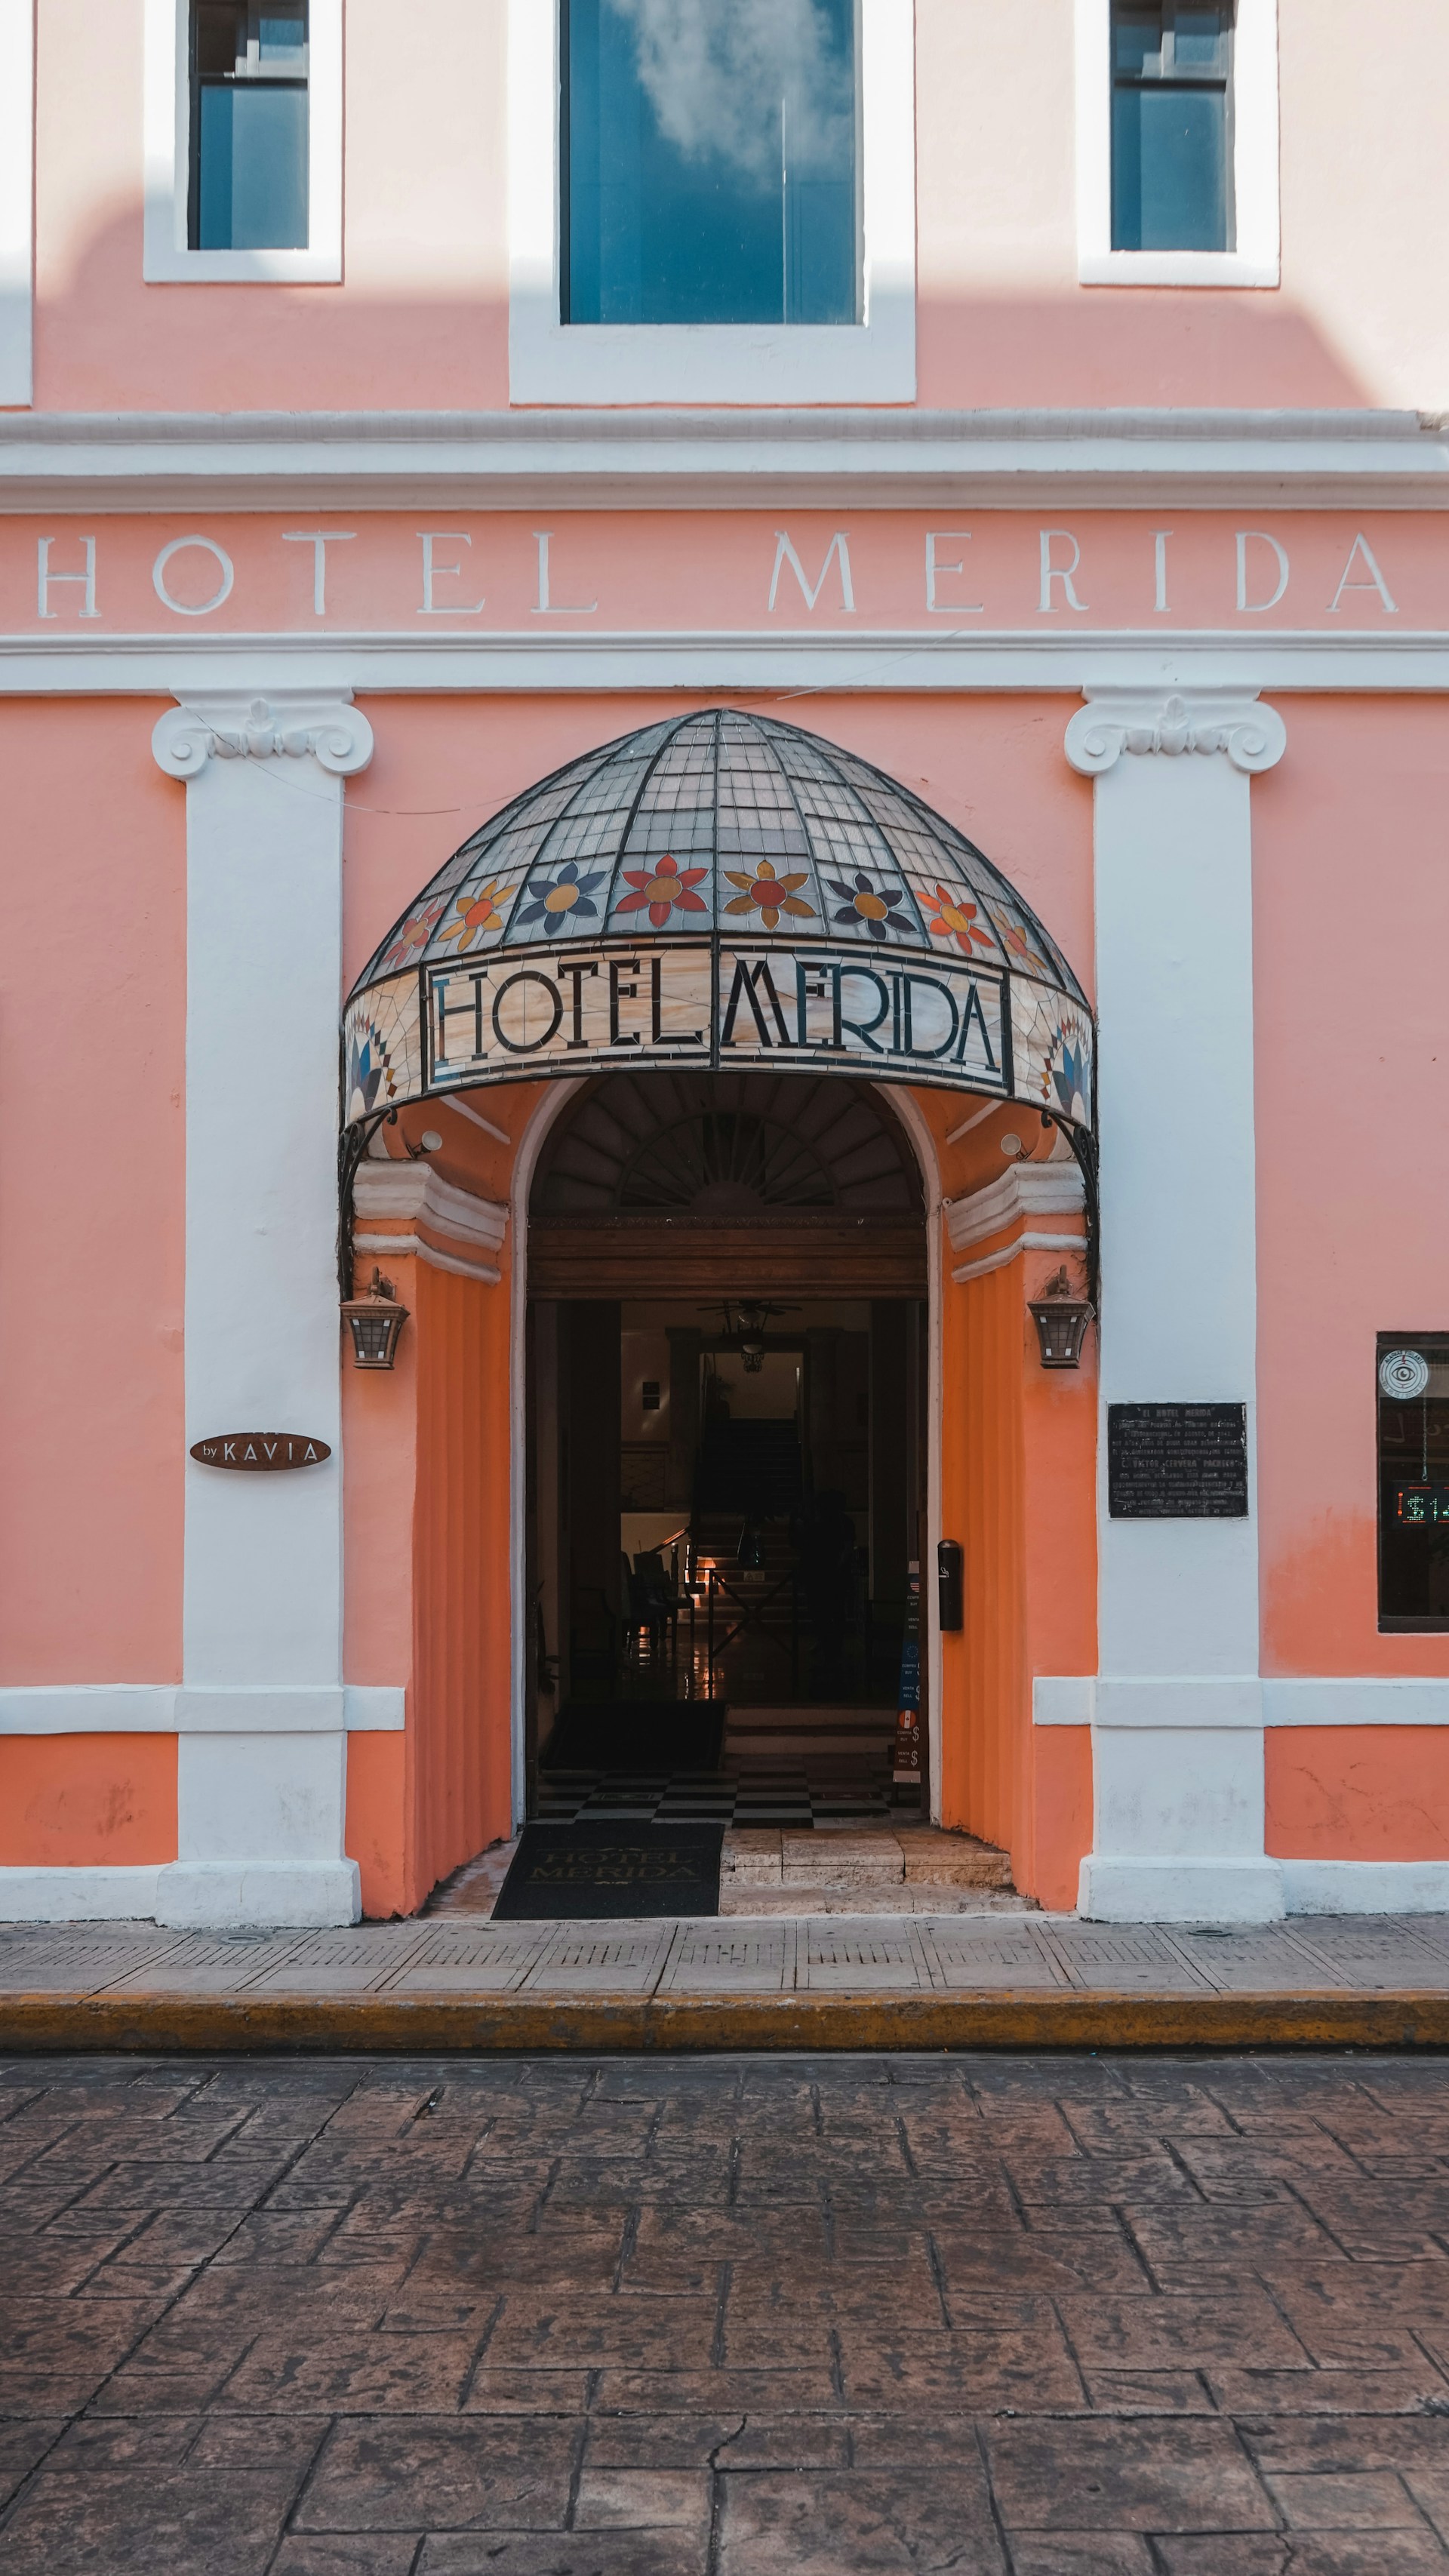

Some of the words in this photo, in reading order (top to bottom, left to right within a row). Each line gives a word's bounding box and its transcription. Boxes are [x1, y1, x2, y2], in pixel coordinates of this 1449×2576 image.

[38, 531, 597, 617] HOTEL
[768, 530, 1399, 613] MERIDA
[430, 957, 703, 1063] HOTEL
[720, 959, 1001, 1067] MERIDA
[1156, 1409, 1179, 1417] HOTEL
[1185, 1408, 1212, 1417] MERIDA
[203, 1445, 217, 1458] by
[224, 1442, 318, 1461] KAVIA
[1164, 1460, 1198, 1468] CERVERA
[1203, 1460, 1235, 1468] PACHECO
[544, 1852, 694, 1864] HOTEL
[530, 1867, 697, 1879] MERIDA
